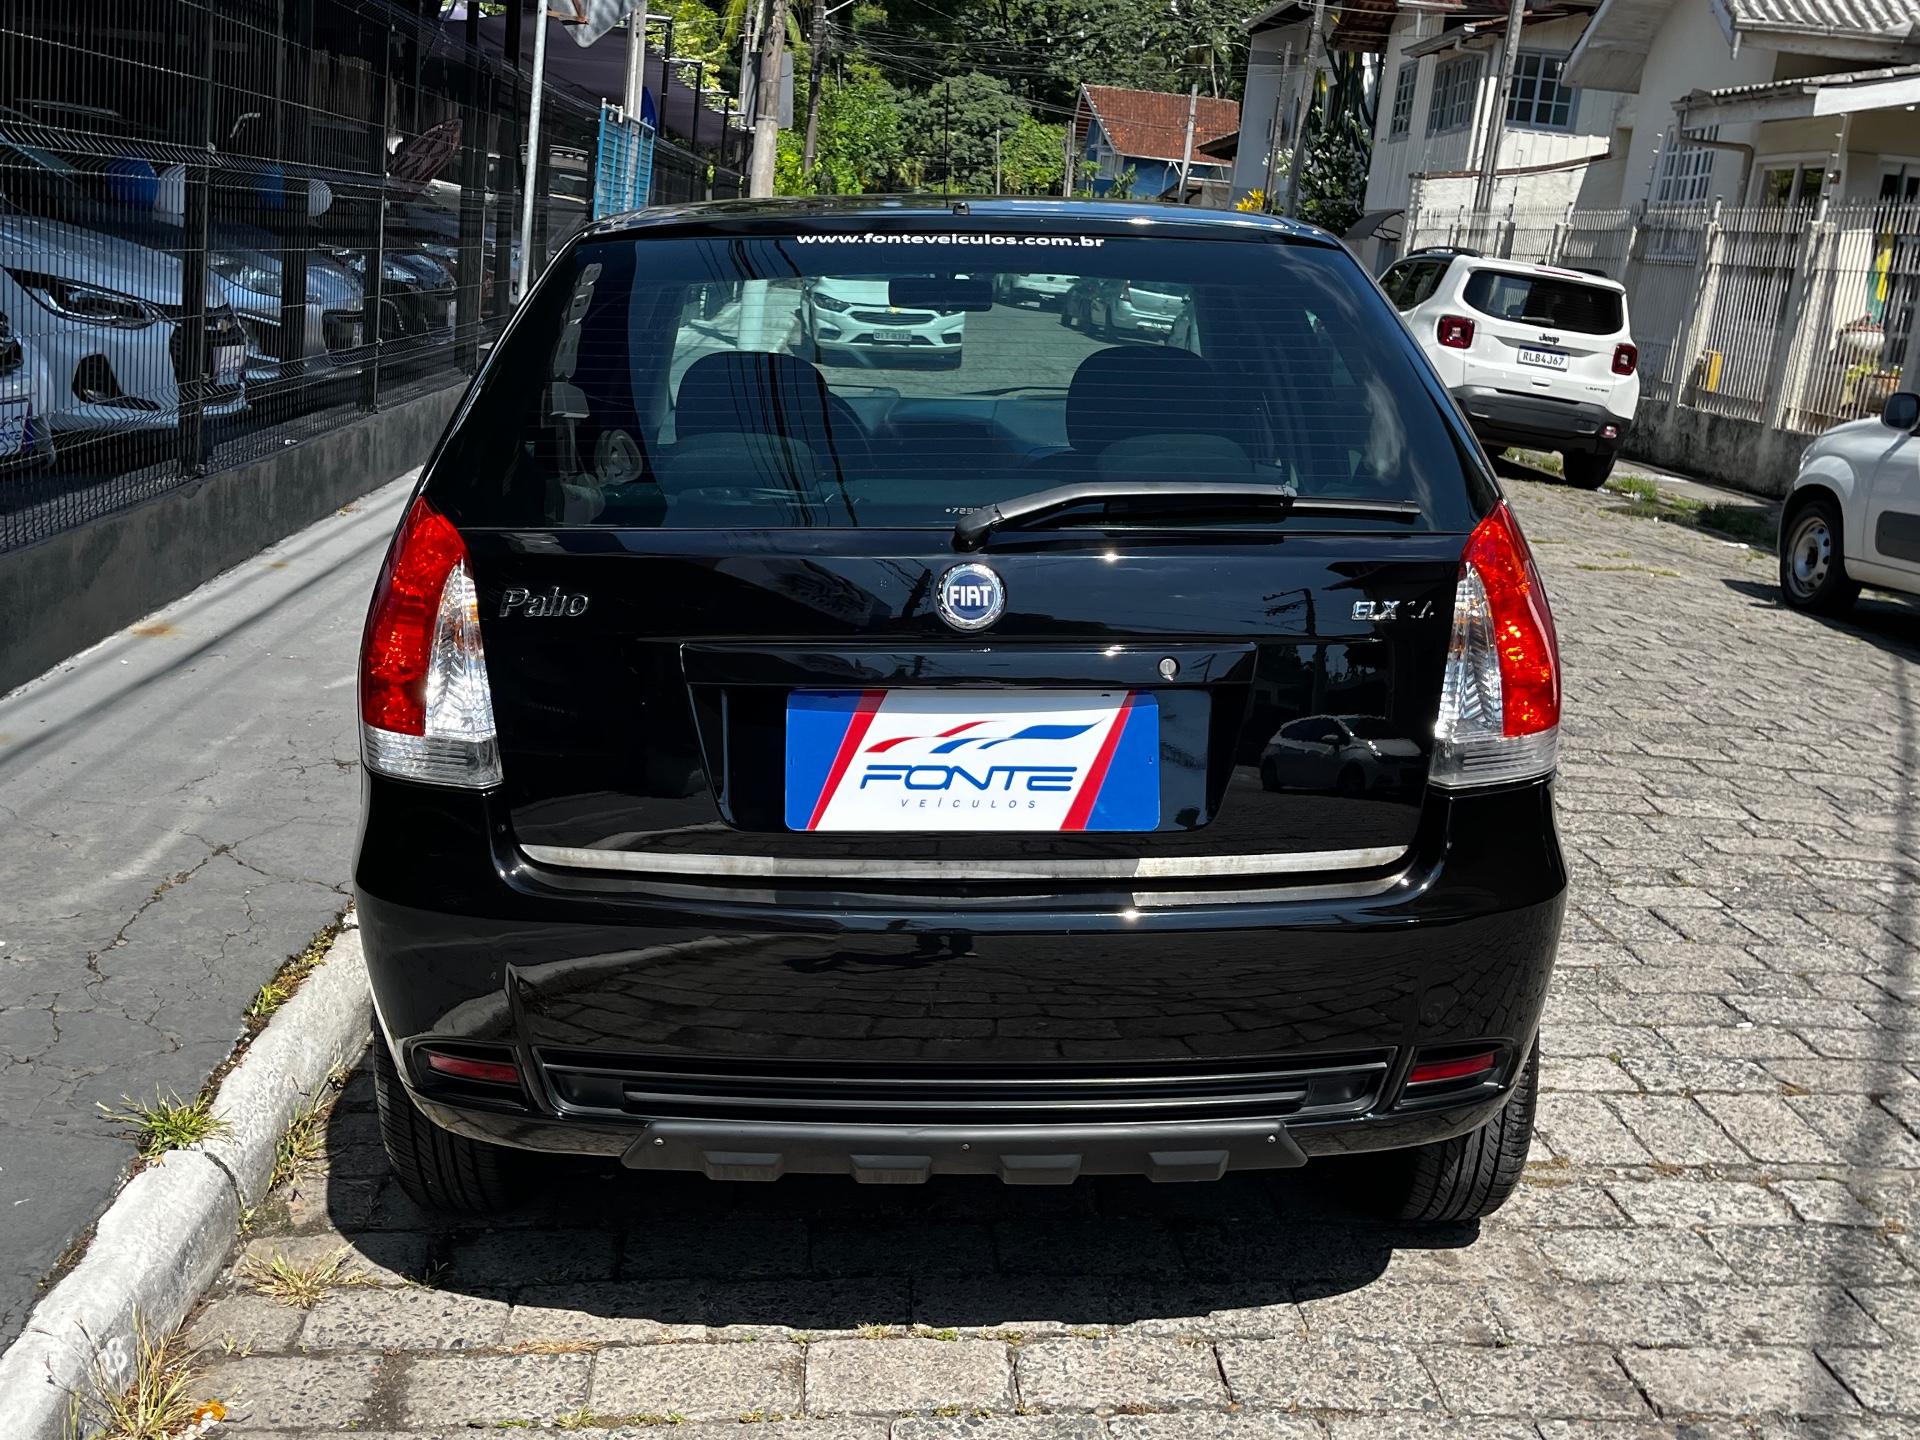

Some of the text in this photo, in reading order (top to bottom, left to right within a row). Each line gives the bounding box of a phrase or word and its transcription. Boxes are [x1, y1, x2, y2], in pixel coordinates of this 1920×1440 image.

[797, 233, 1105, 247] www.fonteveiculos.com.br
[1522, 351, 1565, 366] RLB4J67
[499, 586, 589, 617] Palio
[950, 585, 992, 607] FIAT
[860, 765, 1078, 792] FONTE
[901, 798, 1036, 809] VEÍCULOS
